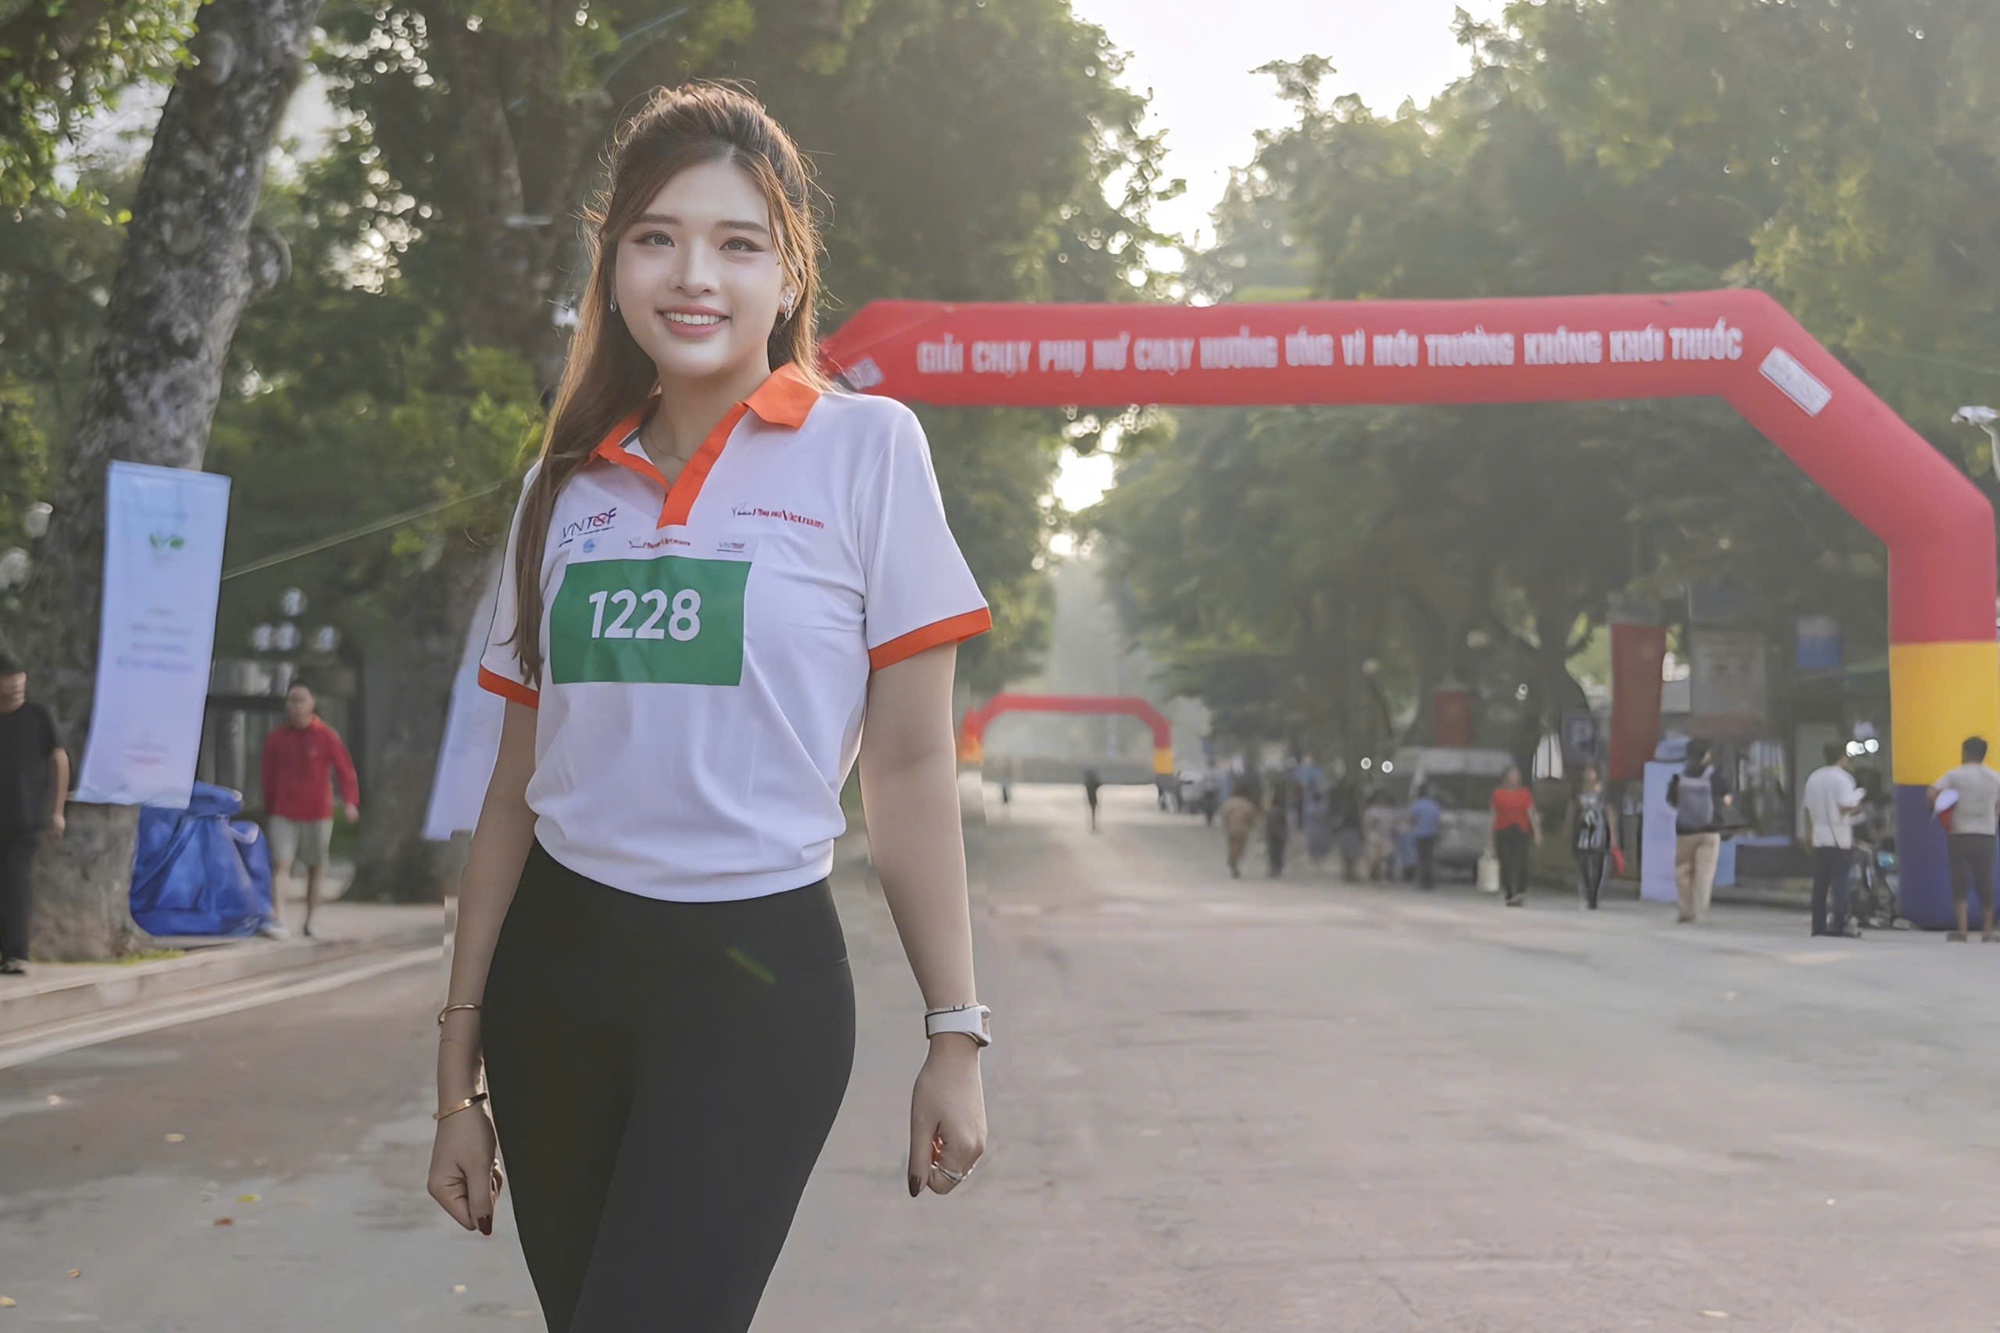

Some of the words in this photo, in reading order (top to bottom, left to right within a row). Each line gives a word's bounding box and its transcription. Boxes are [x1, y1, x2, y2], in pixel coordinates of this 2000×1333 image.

[971, 340, 1031, 377] CHẠY
[1523, 325, 1603, 365] KHÔNG
[1609, 322, 1665, 363] KHÓI
[1668, 315, 1743, 361] THUỐC
[589, 588, 702, 642] 1228
